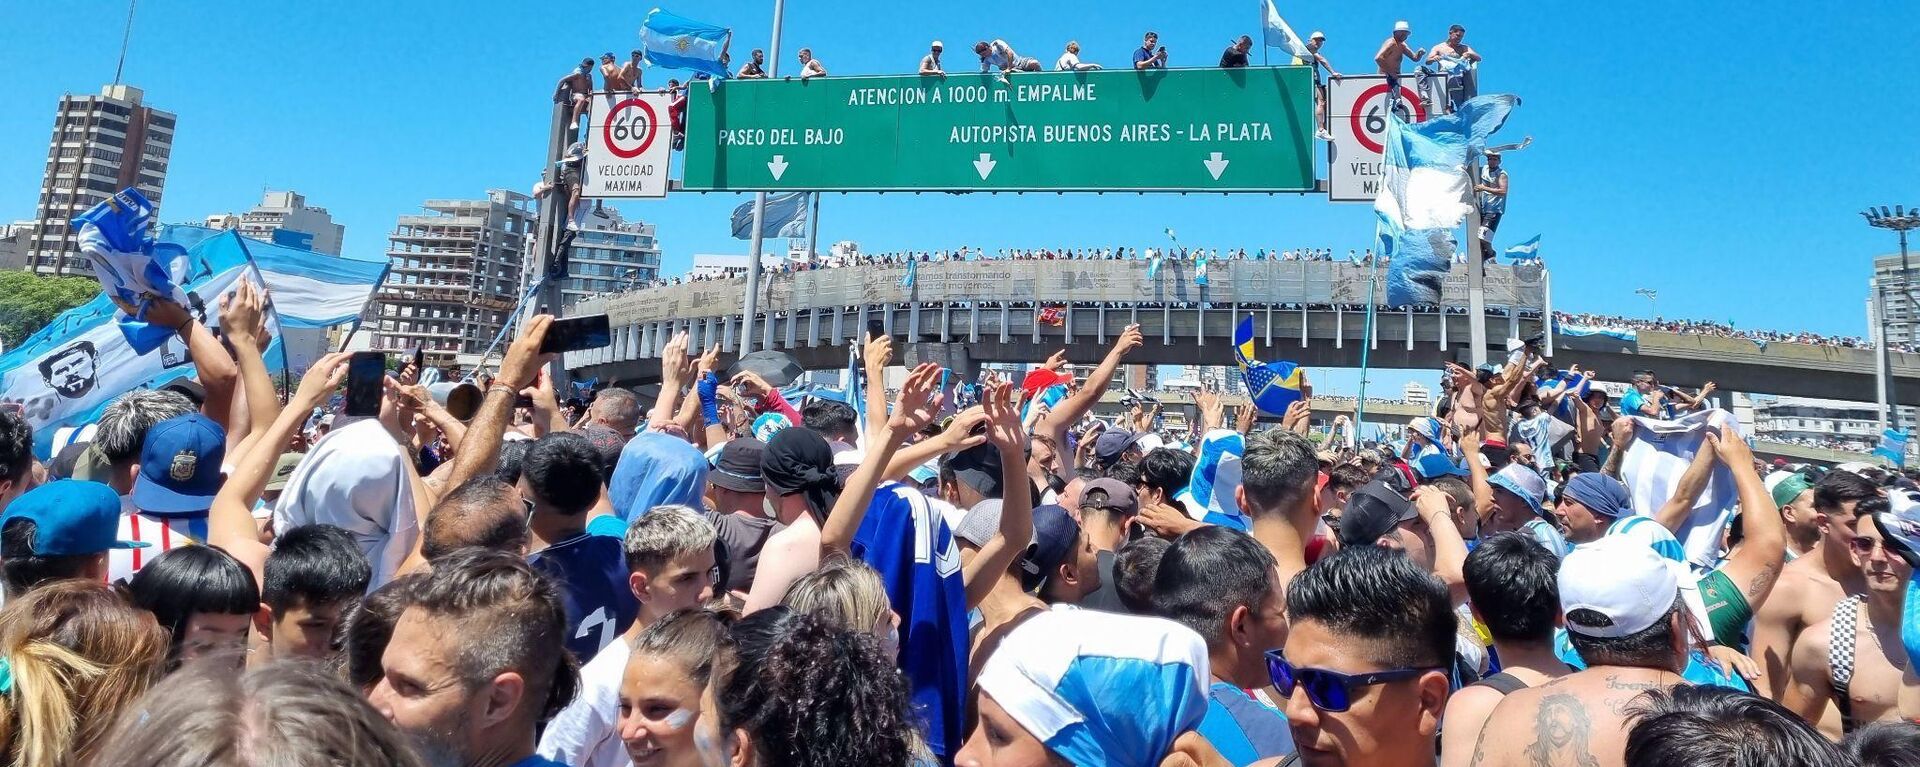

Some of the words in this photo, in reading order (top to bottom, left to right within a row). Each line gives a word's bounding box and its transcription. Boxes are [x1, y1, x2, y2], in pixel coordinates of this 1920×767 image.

[848, 87, 926, 106] ATENCION
[932, 87, 942, 103] A
[949, 86, 987, 103] 1000
[994, 89, 1011, 103] m.
[1017, 84, 1097, 101] EMPALME
[613, 115, 647, 141] 60
[718, 129, 765, 146] PASEO
[770, 129, 798, 145] DEL
[805, 128, 844, 145] BAJO
[950, 126, 1037, 143] AUTOPISTA
[1044, 125, 1112, 142] BUENOS
[1120, 123, 1171, 142] AIRES
[1190, 123, 1211, 141] LA
[1217, 122, 1272, 141] PLATA
[598, 164, 654, 177] VELOCIDAD
[604, 180, 642, 192] MAXIMA
[945, 272, 1011, 280] transformando
